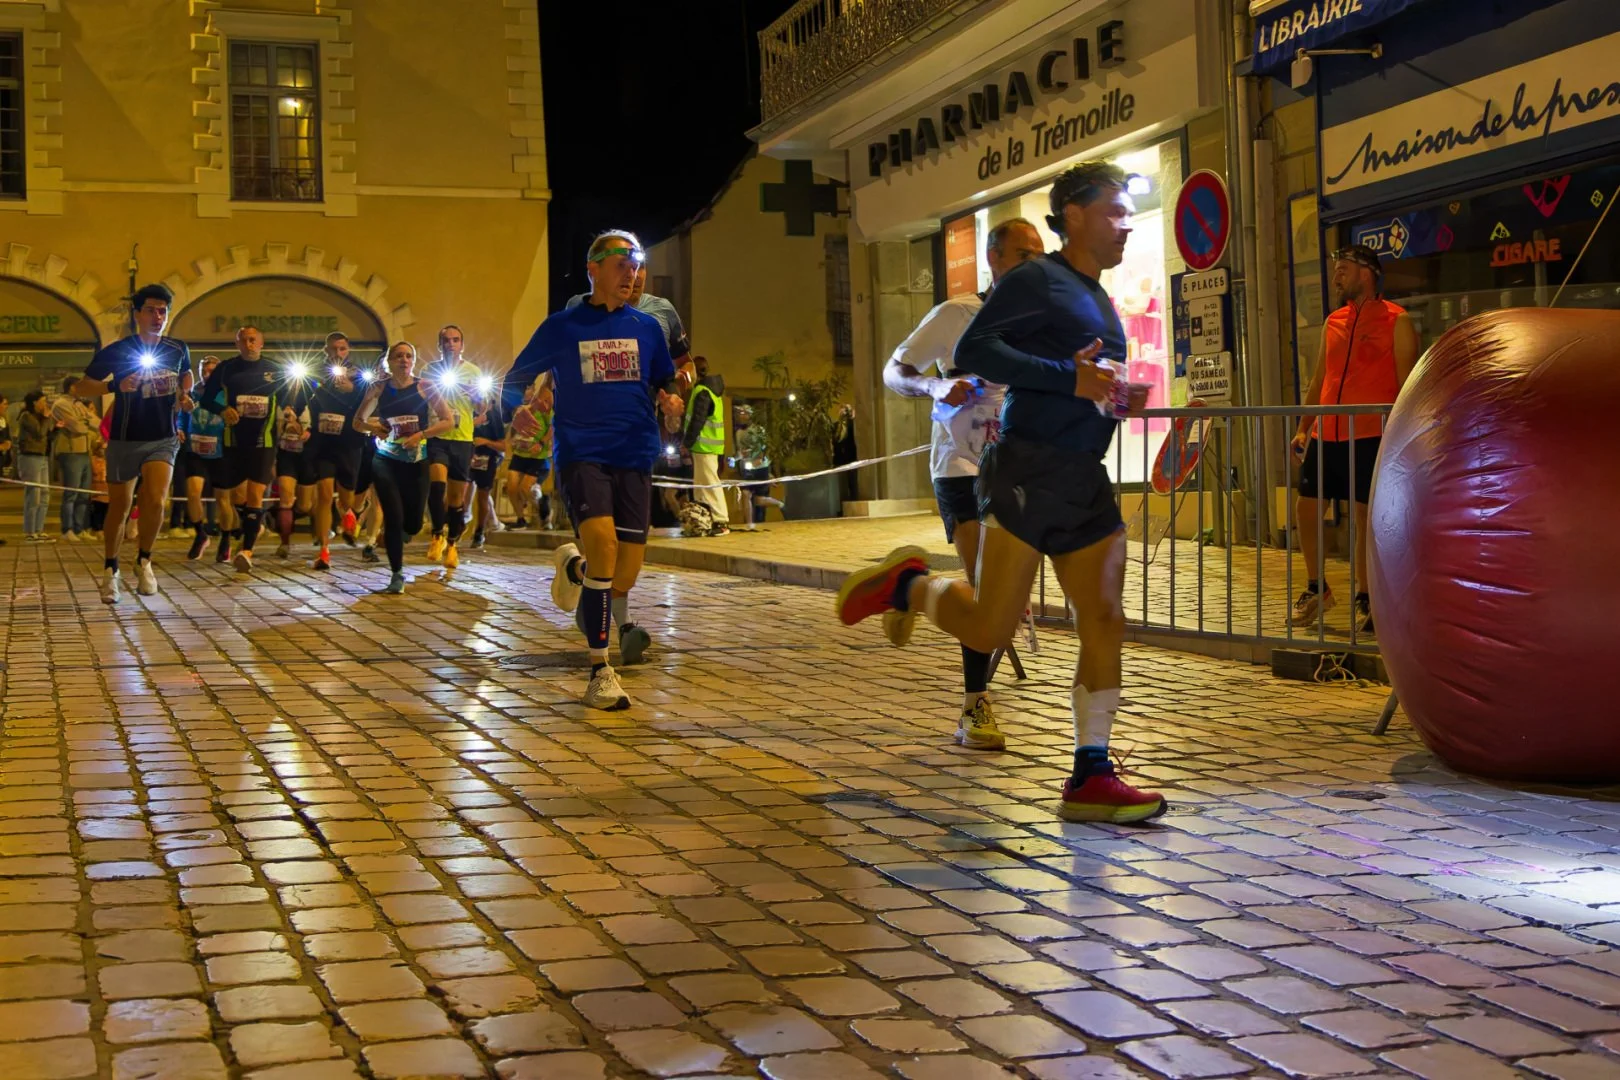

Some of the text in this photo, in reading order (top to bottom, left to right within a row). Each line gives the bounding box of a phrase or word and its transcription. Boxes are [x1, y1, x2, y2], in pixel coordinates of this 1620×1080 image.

[868, 20, 1127, 177] PHARMACIE
[977, 87, 1135, 181] de la Trémoille
[1362, 232, 1384, 250] FDJ
[1183, 277, 1225, 293] 5 PLACES
[9, 355, 34, 365] PAIN
[591, 351, 630, 371] 1506
[1200, 368, 1226, 379] SAMEDI
